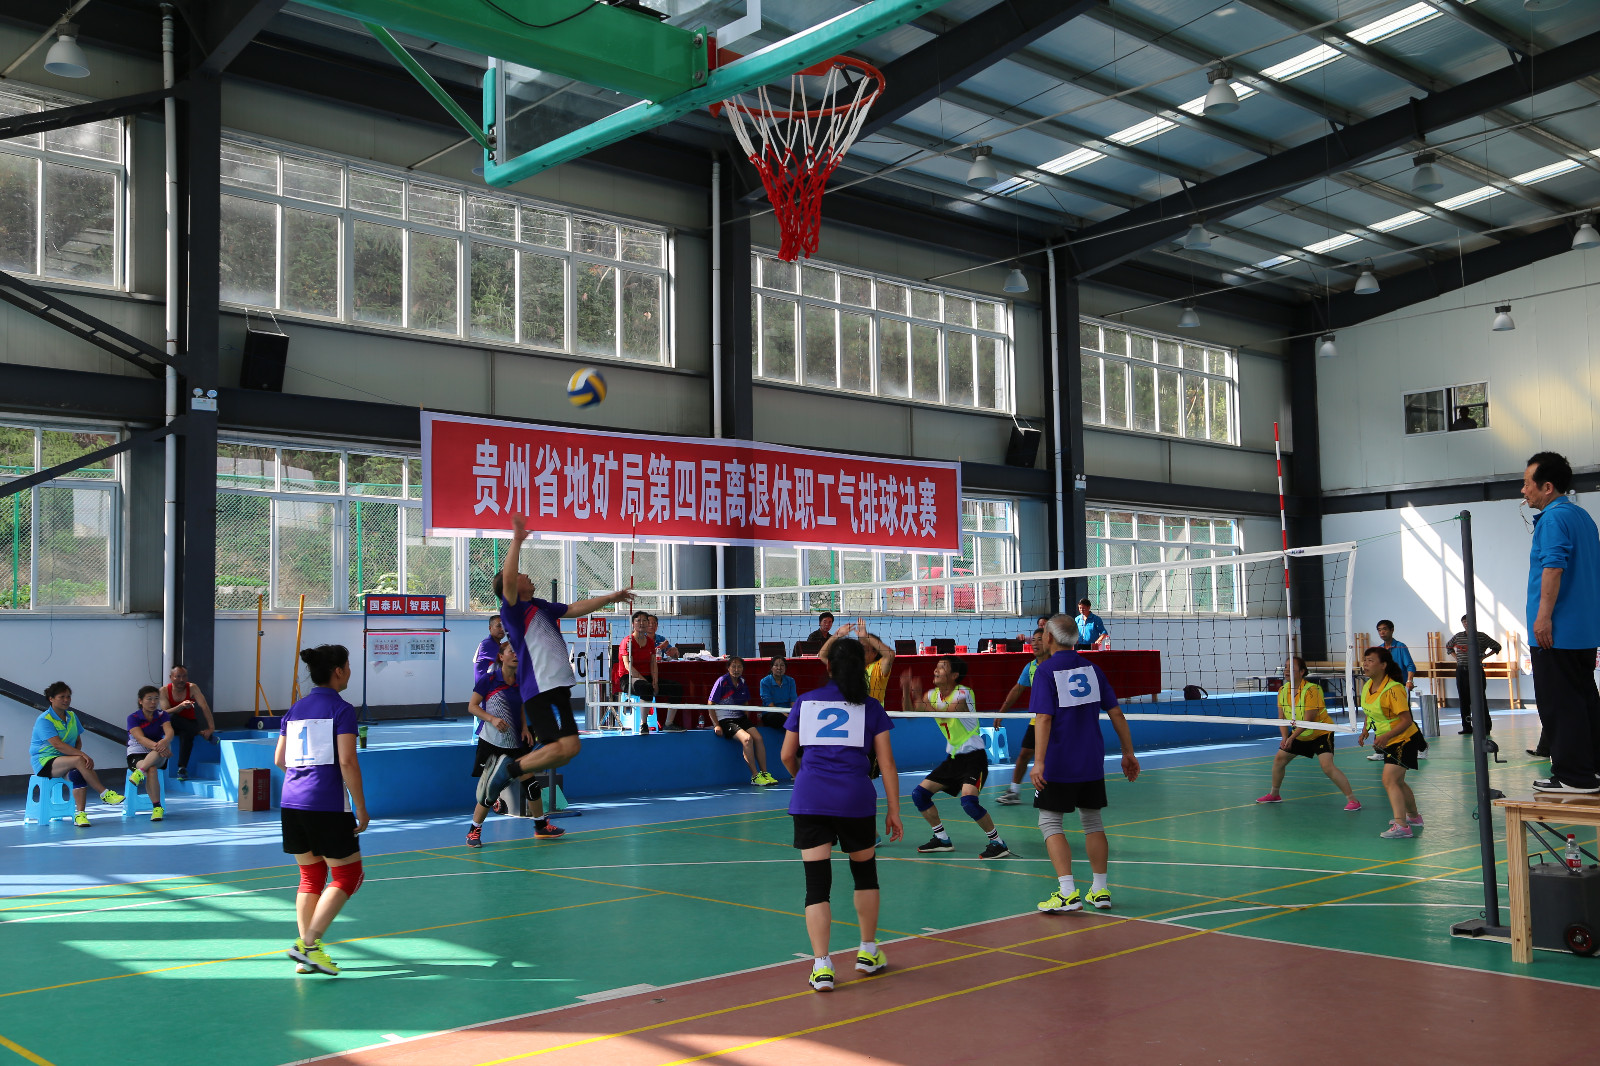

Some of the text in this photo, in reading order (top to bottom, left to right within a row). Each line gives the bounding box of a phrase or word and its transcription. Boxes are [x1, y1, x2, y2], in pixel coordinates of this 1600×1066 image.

[472, 438, 937, 538] 贵州省地矿局第四届离退休职工气排球决赛
[369, 599, 402, 611] 国泰队
[409, 599, 441, 611] 智联队
[1067, 673, 1091, 698] 3
[815, 707, 849, 739] 2
[298, 726, 309, 756] 1
